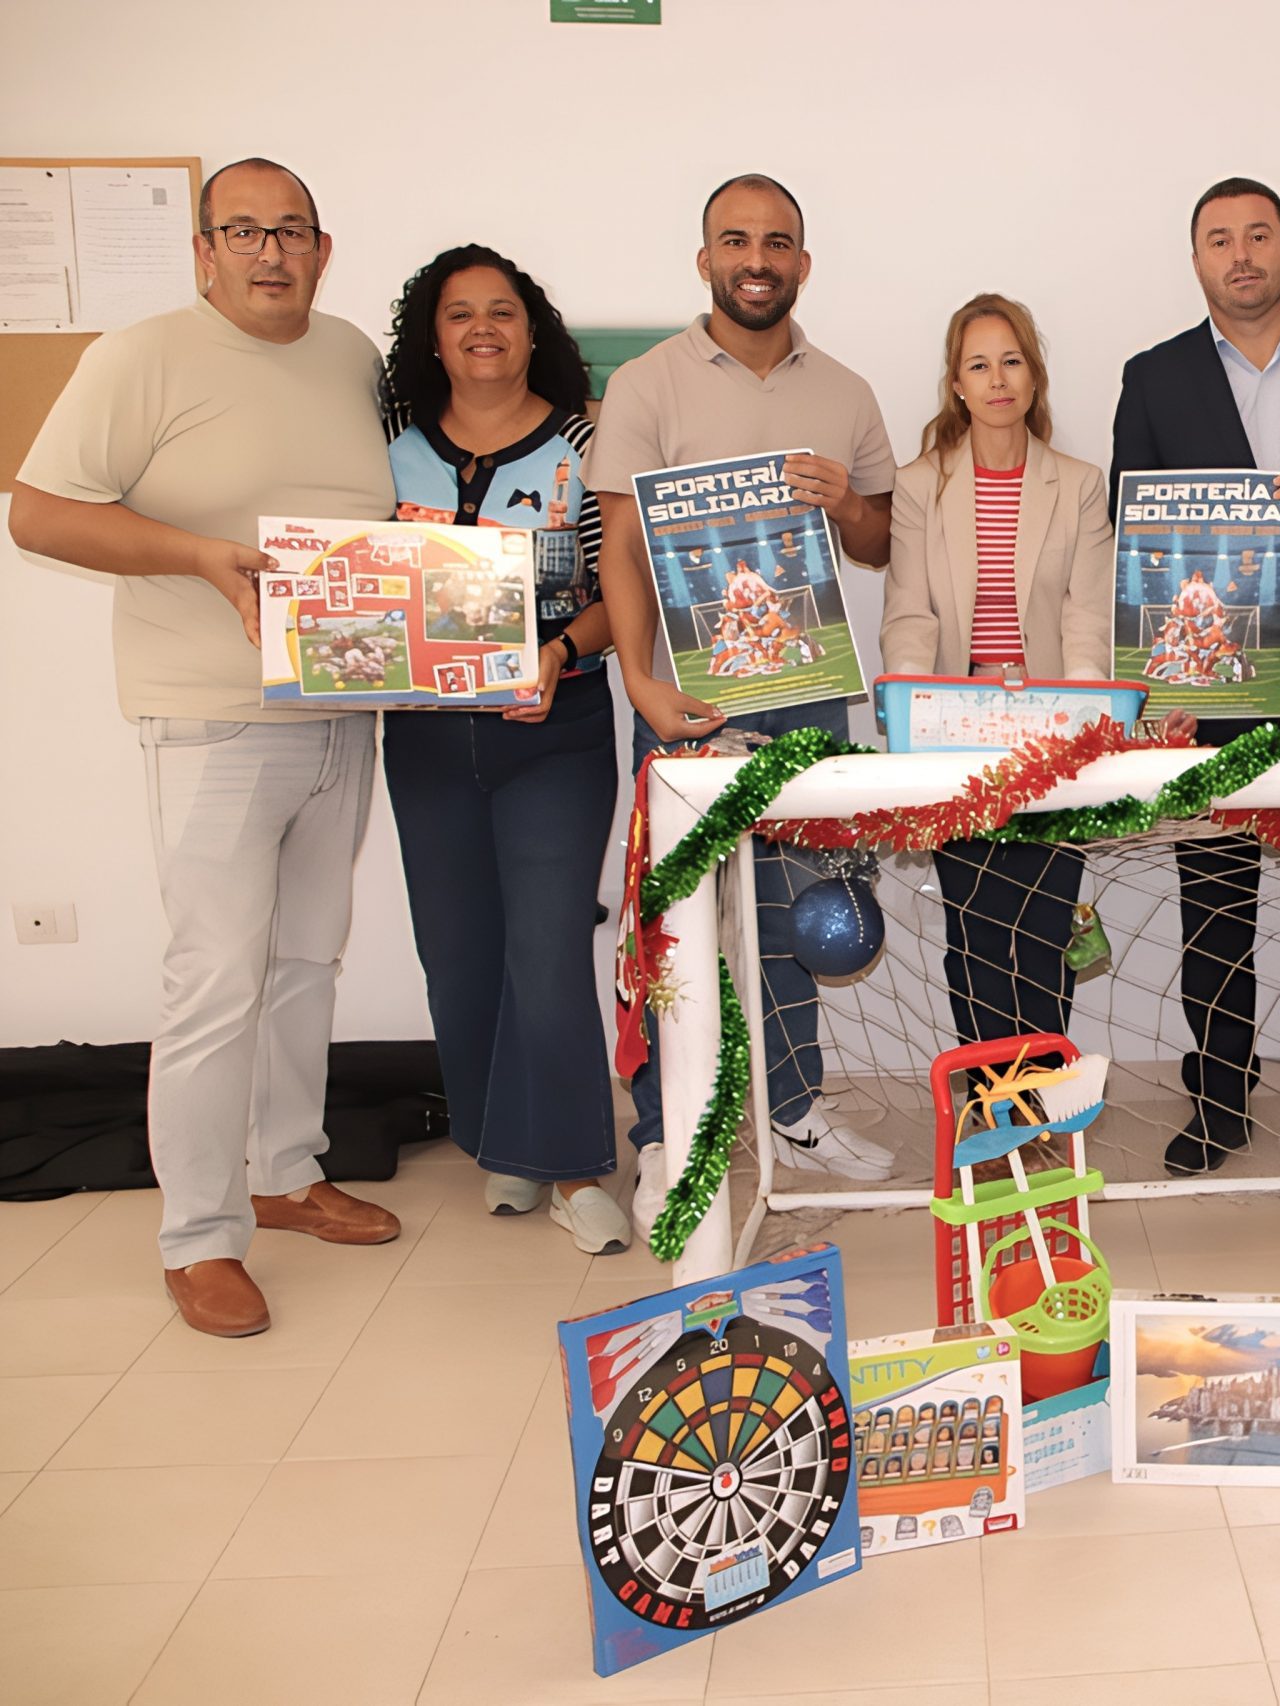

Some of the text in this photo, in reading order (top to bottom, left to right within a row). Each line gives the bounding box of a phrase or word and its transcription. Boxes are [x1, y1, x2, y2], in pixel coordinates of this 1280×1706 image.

[654, 460, 785, 501] PORTERÍ
[1136, 478, 1272, 502] PORTERÍA
[646, 485, 794, 523] SOLIDARI
[709, 1338, 729, 1354] 20
[812, 1362, 822, 1376] 4
[637, 1387, 653, 1403] 12
[591, 1476, 693, 1628] DART GAME
